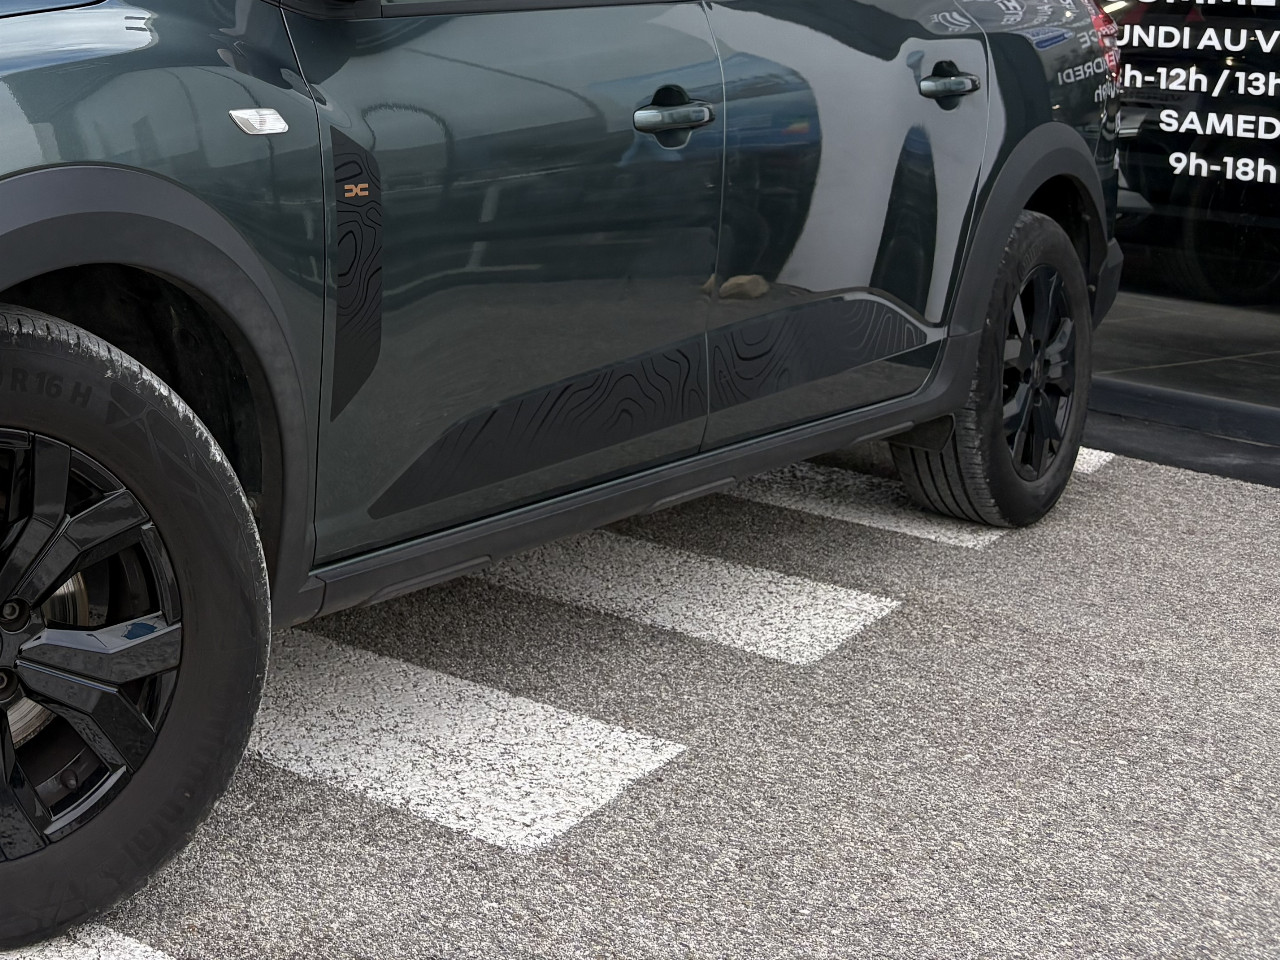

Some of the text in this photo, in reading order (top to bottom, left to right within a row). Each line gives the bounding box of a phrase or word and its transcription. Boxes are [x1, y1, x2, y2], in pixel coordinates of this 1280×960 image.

[1197, 27, 1248, 52] AU
[1119, 63, 1208, 93] h-12h
[1159, 109, 1280, 140] SAMED
[1169, 151, 1277, 185] 9h-18h
[10, 367, 29, 393] R
[36, 372, 64, 400] 16
[69, 380, 93, 408] H
